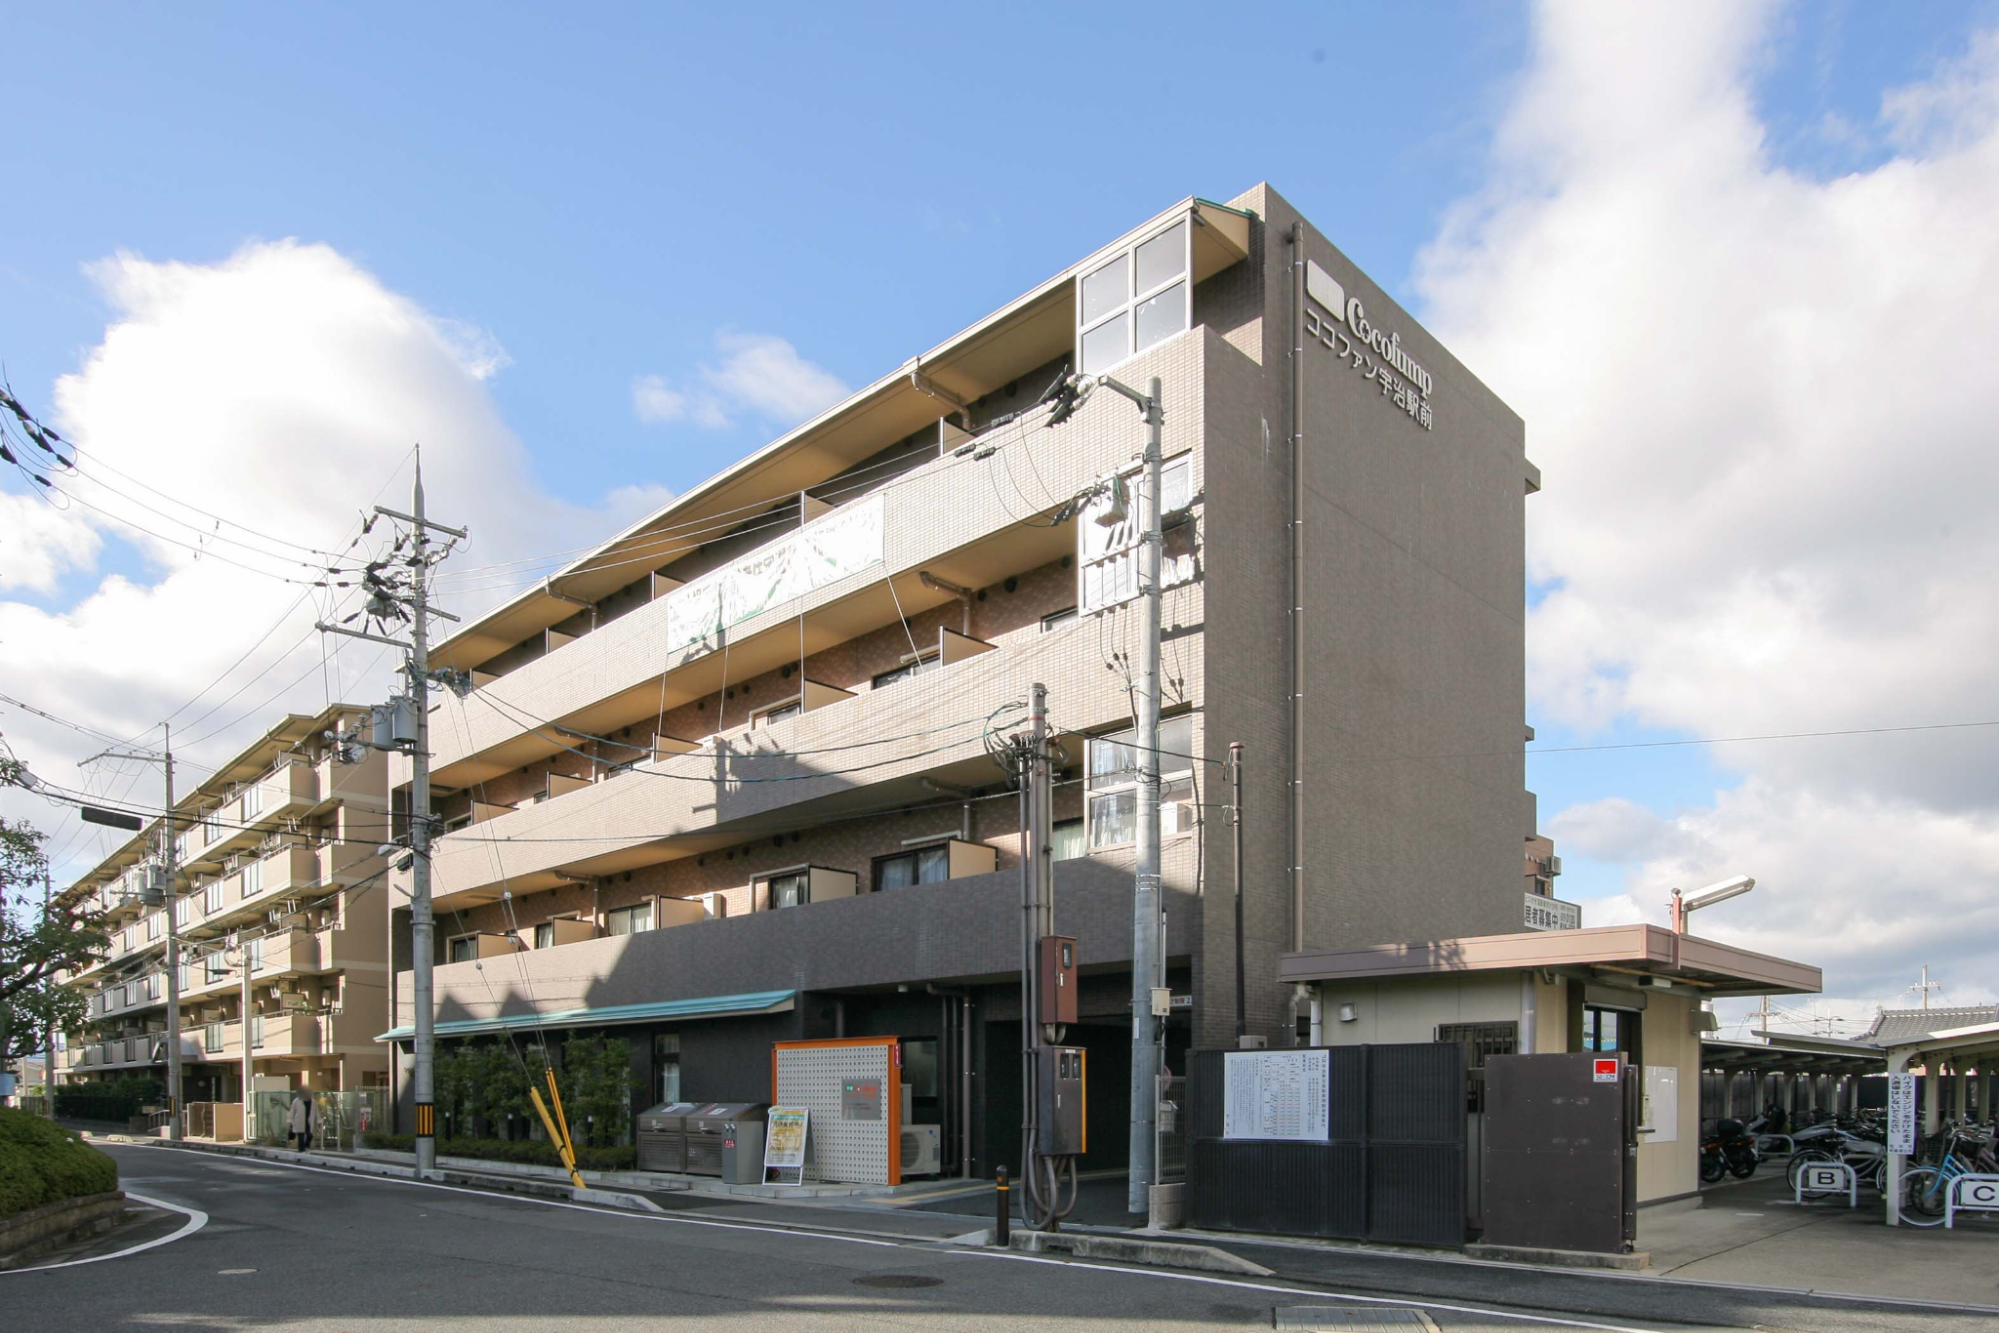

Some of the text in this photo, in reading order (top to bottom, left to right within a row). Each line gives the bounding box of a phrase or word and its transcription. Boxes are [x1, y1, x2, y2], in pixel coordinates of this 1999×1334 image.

[1306, 308, 1432, 430] ココファン宇治駅前
[1347, 297, 1432, 399] Cocofump
[1817, 1172, 1835, 1184] B
[1973, 1186, 1995, 1201] C
